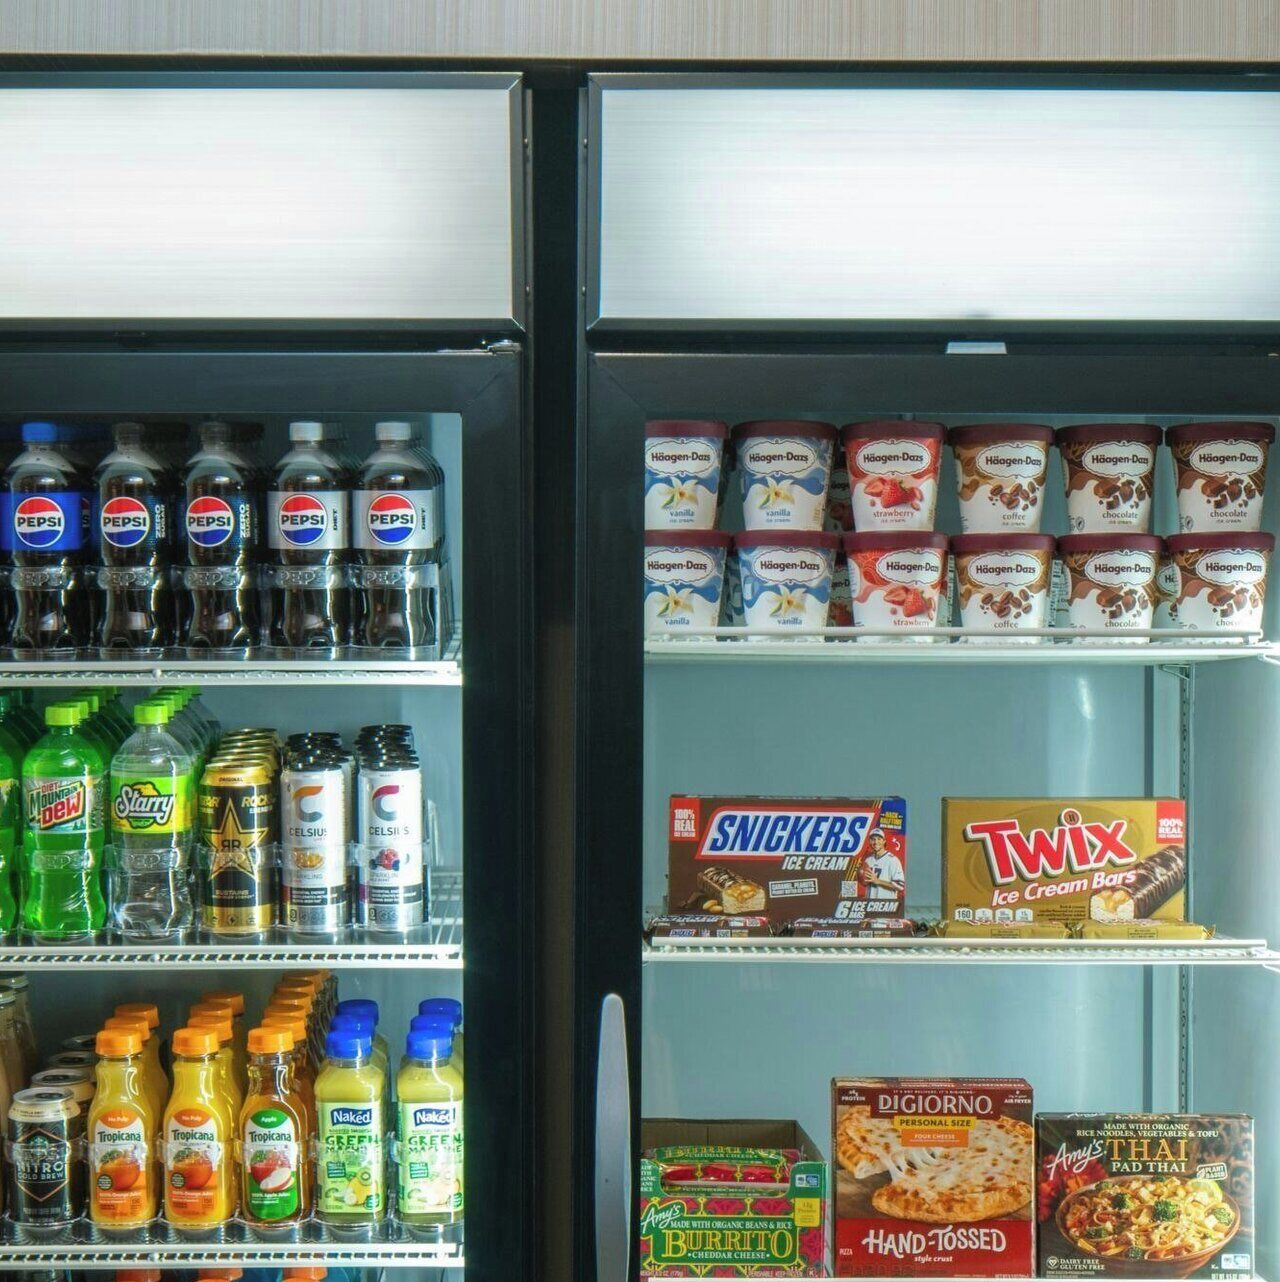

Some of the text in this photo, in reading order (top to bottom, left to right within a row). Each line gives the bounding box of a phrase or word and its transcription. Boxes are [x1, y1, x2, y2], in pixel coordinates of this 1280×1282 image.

[670, 508, 695, 518] vanilla
[766, 508, 791, 518] vanilla
[873, 509, 915, 520] strawberry
[1002, 512, 1026, 521] coffee
[1210, 509, 1248, 518] chocolate
[17, 516, 61, 528] PEPSI
[103, 515, 147, 527] PEPSI
[188, 515, 231, 527] PEPSI
[281, 514, 325, 525] PEPSI
[370, 513, 414, 525] PEPSI
[664, 617, 690, 626] vanilla
[777, 617, 803, 626] vanilla
[994, 620, 1019, 629] coffee
[115, 786, 175, 822] Starry
[674, 809, 695, 819] 100%
[674, 820, 695, 831] REAL
[1158, 818, 1183, 827] 100%
[290, 827, 327, 837] CELSIUS
[710, 814, 869, 853] SNICKERS
[782, 857, 850, 870] ICE CREAM
[992, 870, 1137, 907] Ice Cream Bars
[835, 902, 850, 919] 6
[851, 902, 898, 912] ICE CREAM
[899, 1119, 971, 1127] PERSONAL SIZE
[1104, 1123, 1189, 1131] MADE WITH ORGANIC
[98, 1130, 141, 1143] Tropicana
[172, 1129, 215, 1142] Tropicana
[249, 1130, 292, 1143] Tropicana
[408, 1134, 463, 1145] GREEN
[1106, 1139, 1188, 1161] THAI
[17, 1162, 64, 1173] NITRO
[1112, 1162, 1186, 1172] PAD THAI
[641, 1203, 681, 1234] Amy's
[671, 1220, 793, 1229] MADE WITH ORGANIC BEANS RICE
[662, 1229, 793, 1258] BURRITO
[861, 1225, 1006, 1258] HAND-TOSSED
[692, 1251, 766, 1259] CHEDDAR CHEESE
